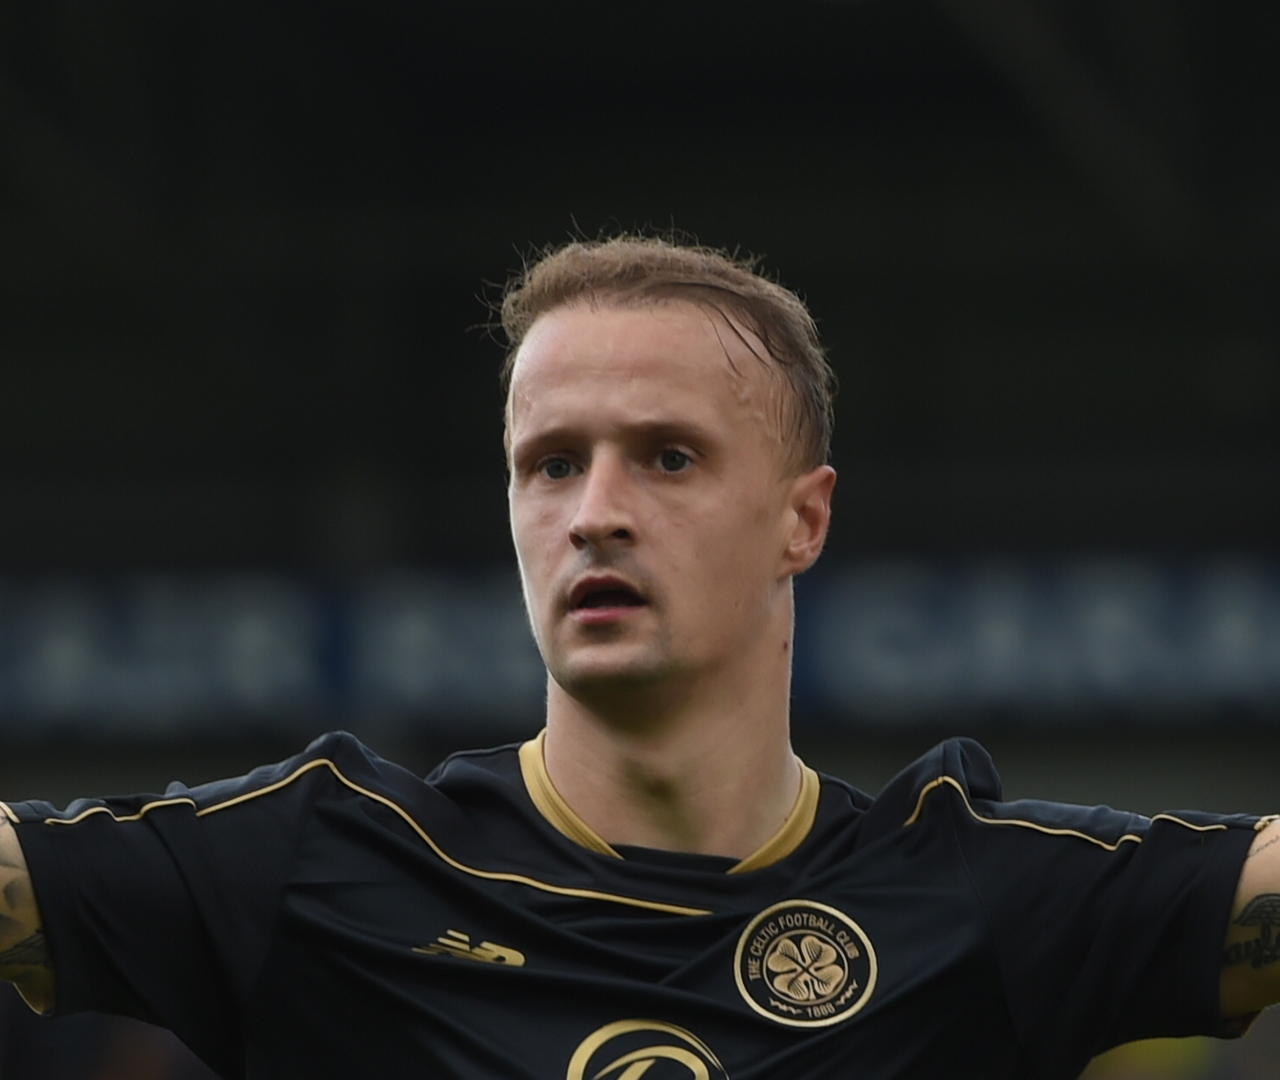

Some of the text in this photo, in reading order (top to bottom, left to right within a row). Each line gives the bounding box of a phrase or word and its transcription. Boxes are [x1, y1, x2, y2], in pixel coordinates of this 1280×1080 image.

[749, 913, 860, 982] THE CELTIC FOOTBALL CLUB
[806, 1004, 836, 1018] 1888
